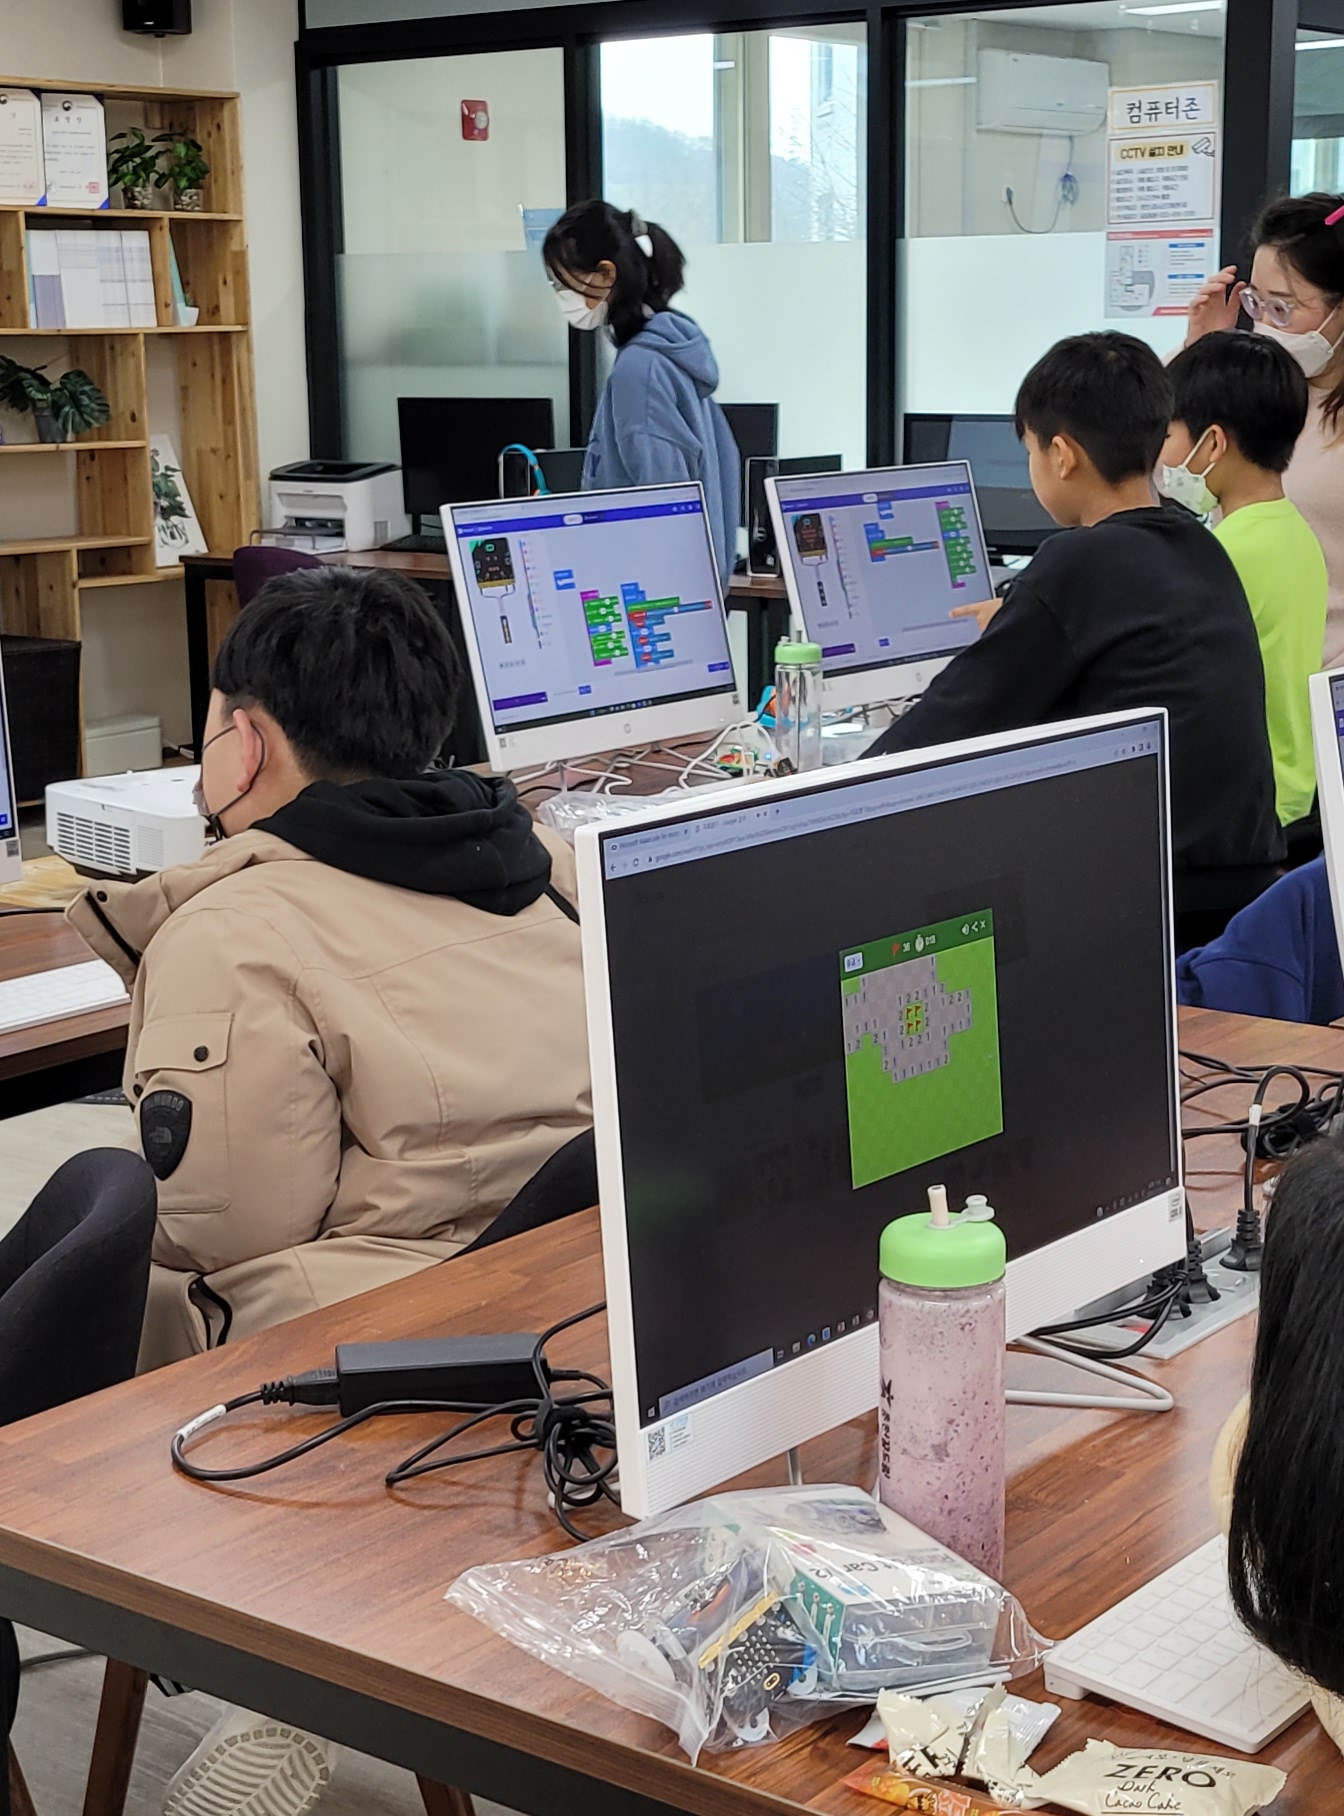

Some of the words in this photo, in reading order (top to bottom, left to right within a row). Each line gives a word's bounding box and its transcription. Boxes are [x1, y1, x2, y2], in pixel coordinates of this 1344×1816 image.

[1126, 96, 1201, 124] 컴퓨터존
[1120, 147, 1147, 159] CCTV
[842, 1561, 880, 1574] Car
[1103, 1763, 1217, 1788] ZERO
[1105, 1793, 1143, 1809] Cacao
[1147, 1792, 1183, 1811] Cake
